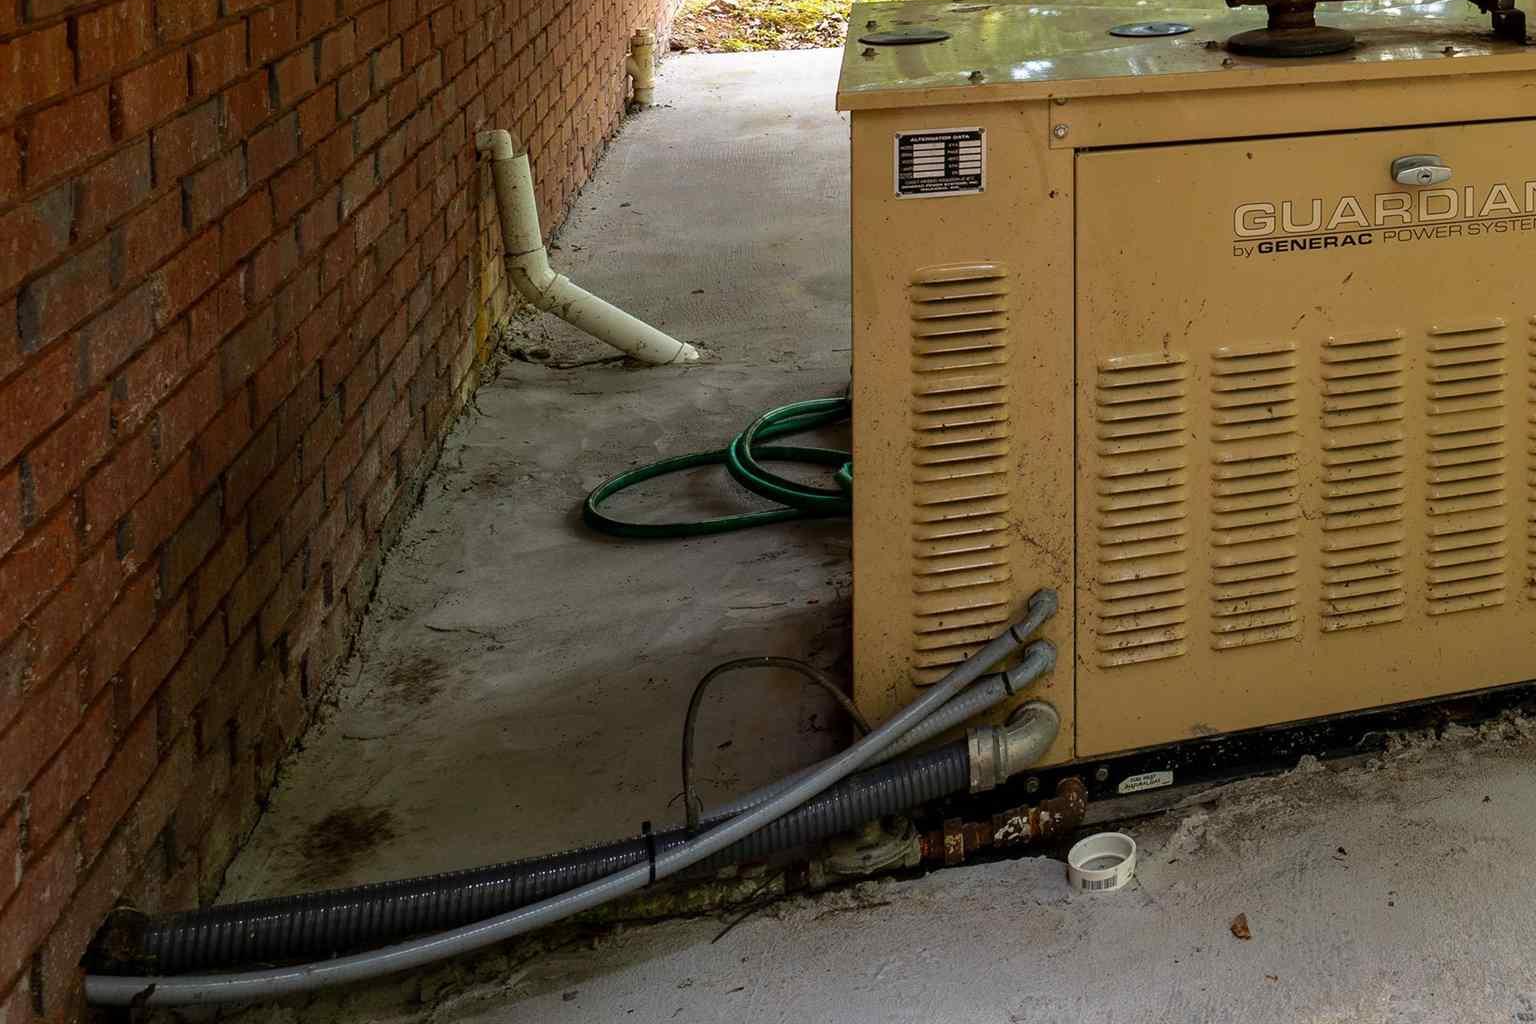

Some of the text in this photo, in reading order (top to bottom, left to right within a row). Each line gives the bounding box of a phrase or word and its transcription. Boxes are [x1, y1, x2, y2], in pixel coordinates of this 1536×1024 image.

[1233, 245, 1254, 259] by
[1258, 232, 1373, 254] GENERAC
[1384, 225, 1462, 243] POWER
